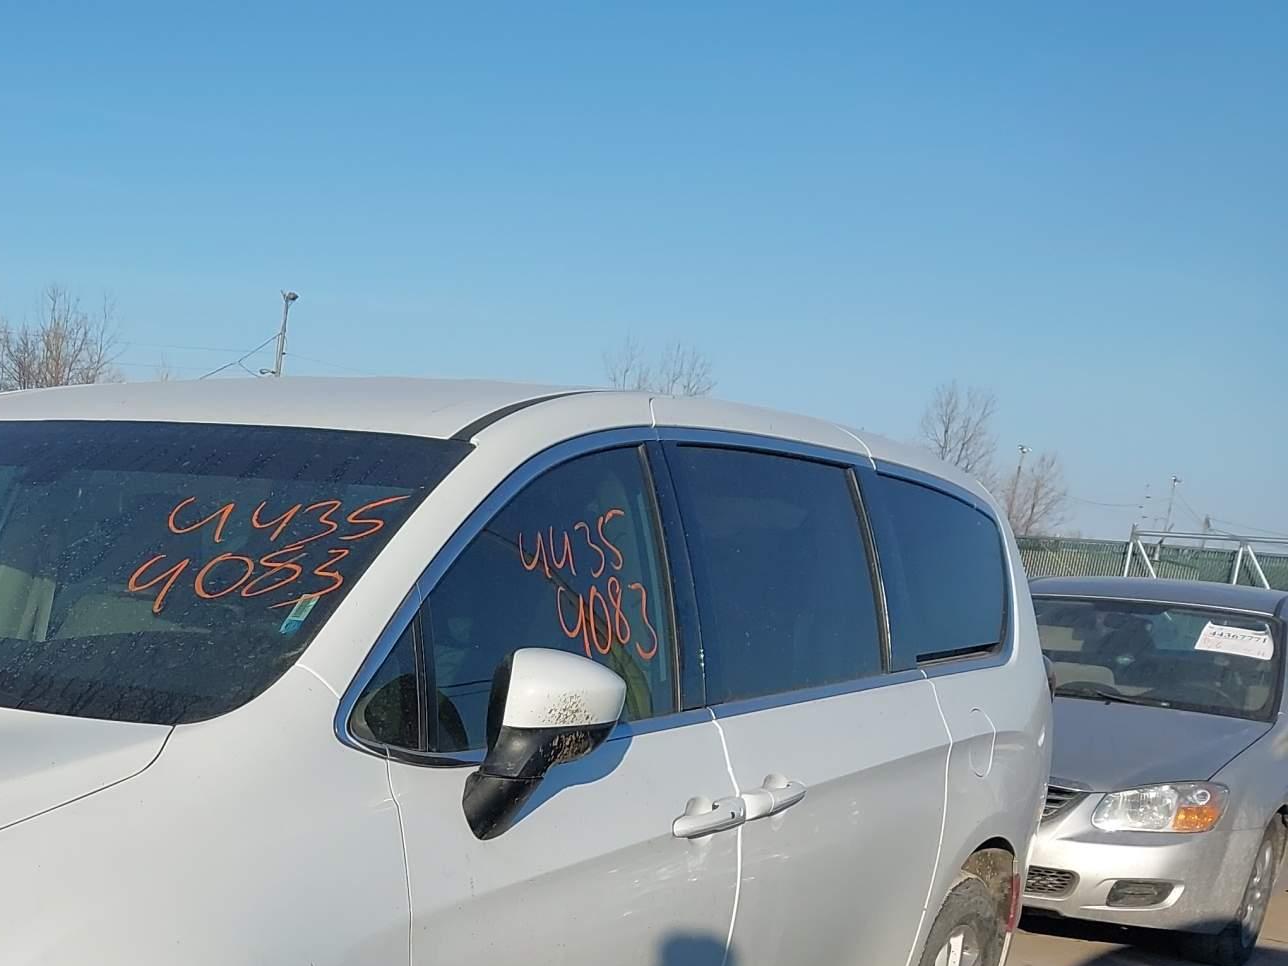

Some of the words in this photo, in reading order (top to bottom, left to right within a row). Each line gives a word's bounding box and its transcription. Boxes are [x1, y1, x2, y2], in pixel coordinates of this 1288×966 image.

[168, 495, 412, 547] 4435
[520, 509, 625, 578] 4435
[128, 544, 351, 614] 4083
[557, 577, 658, 660] 4083
